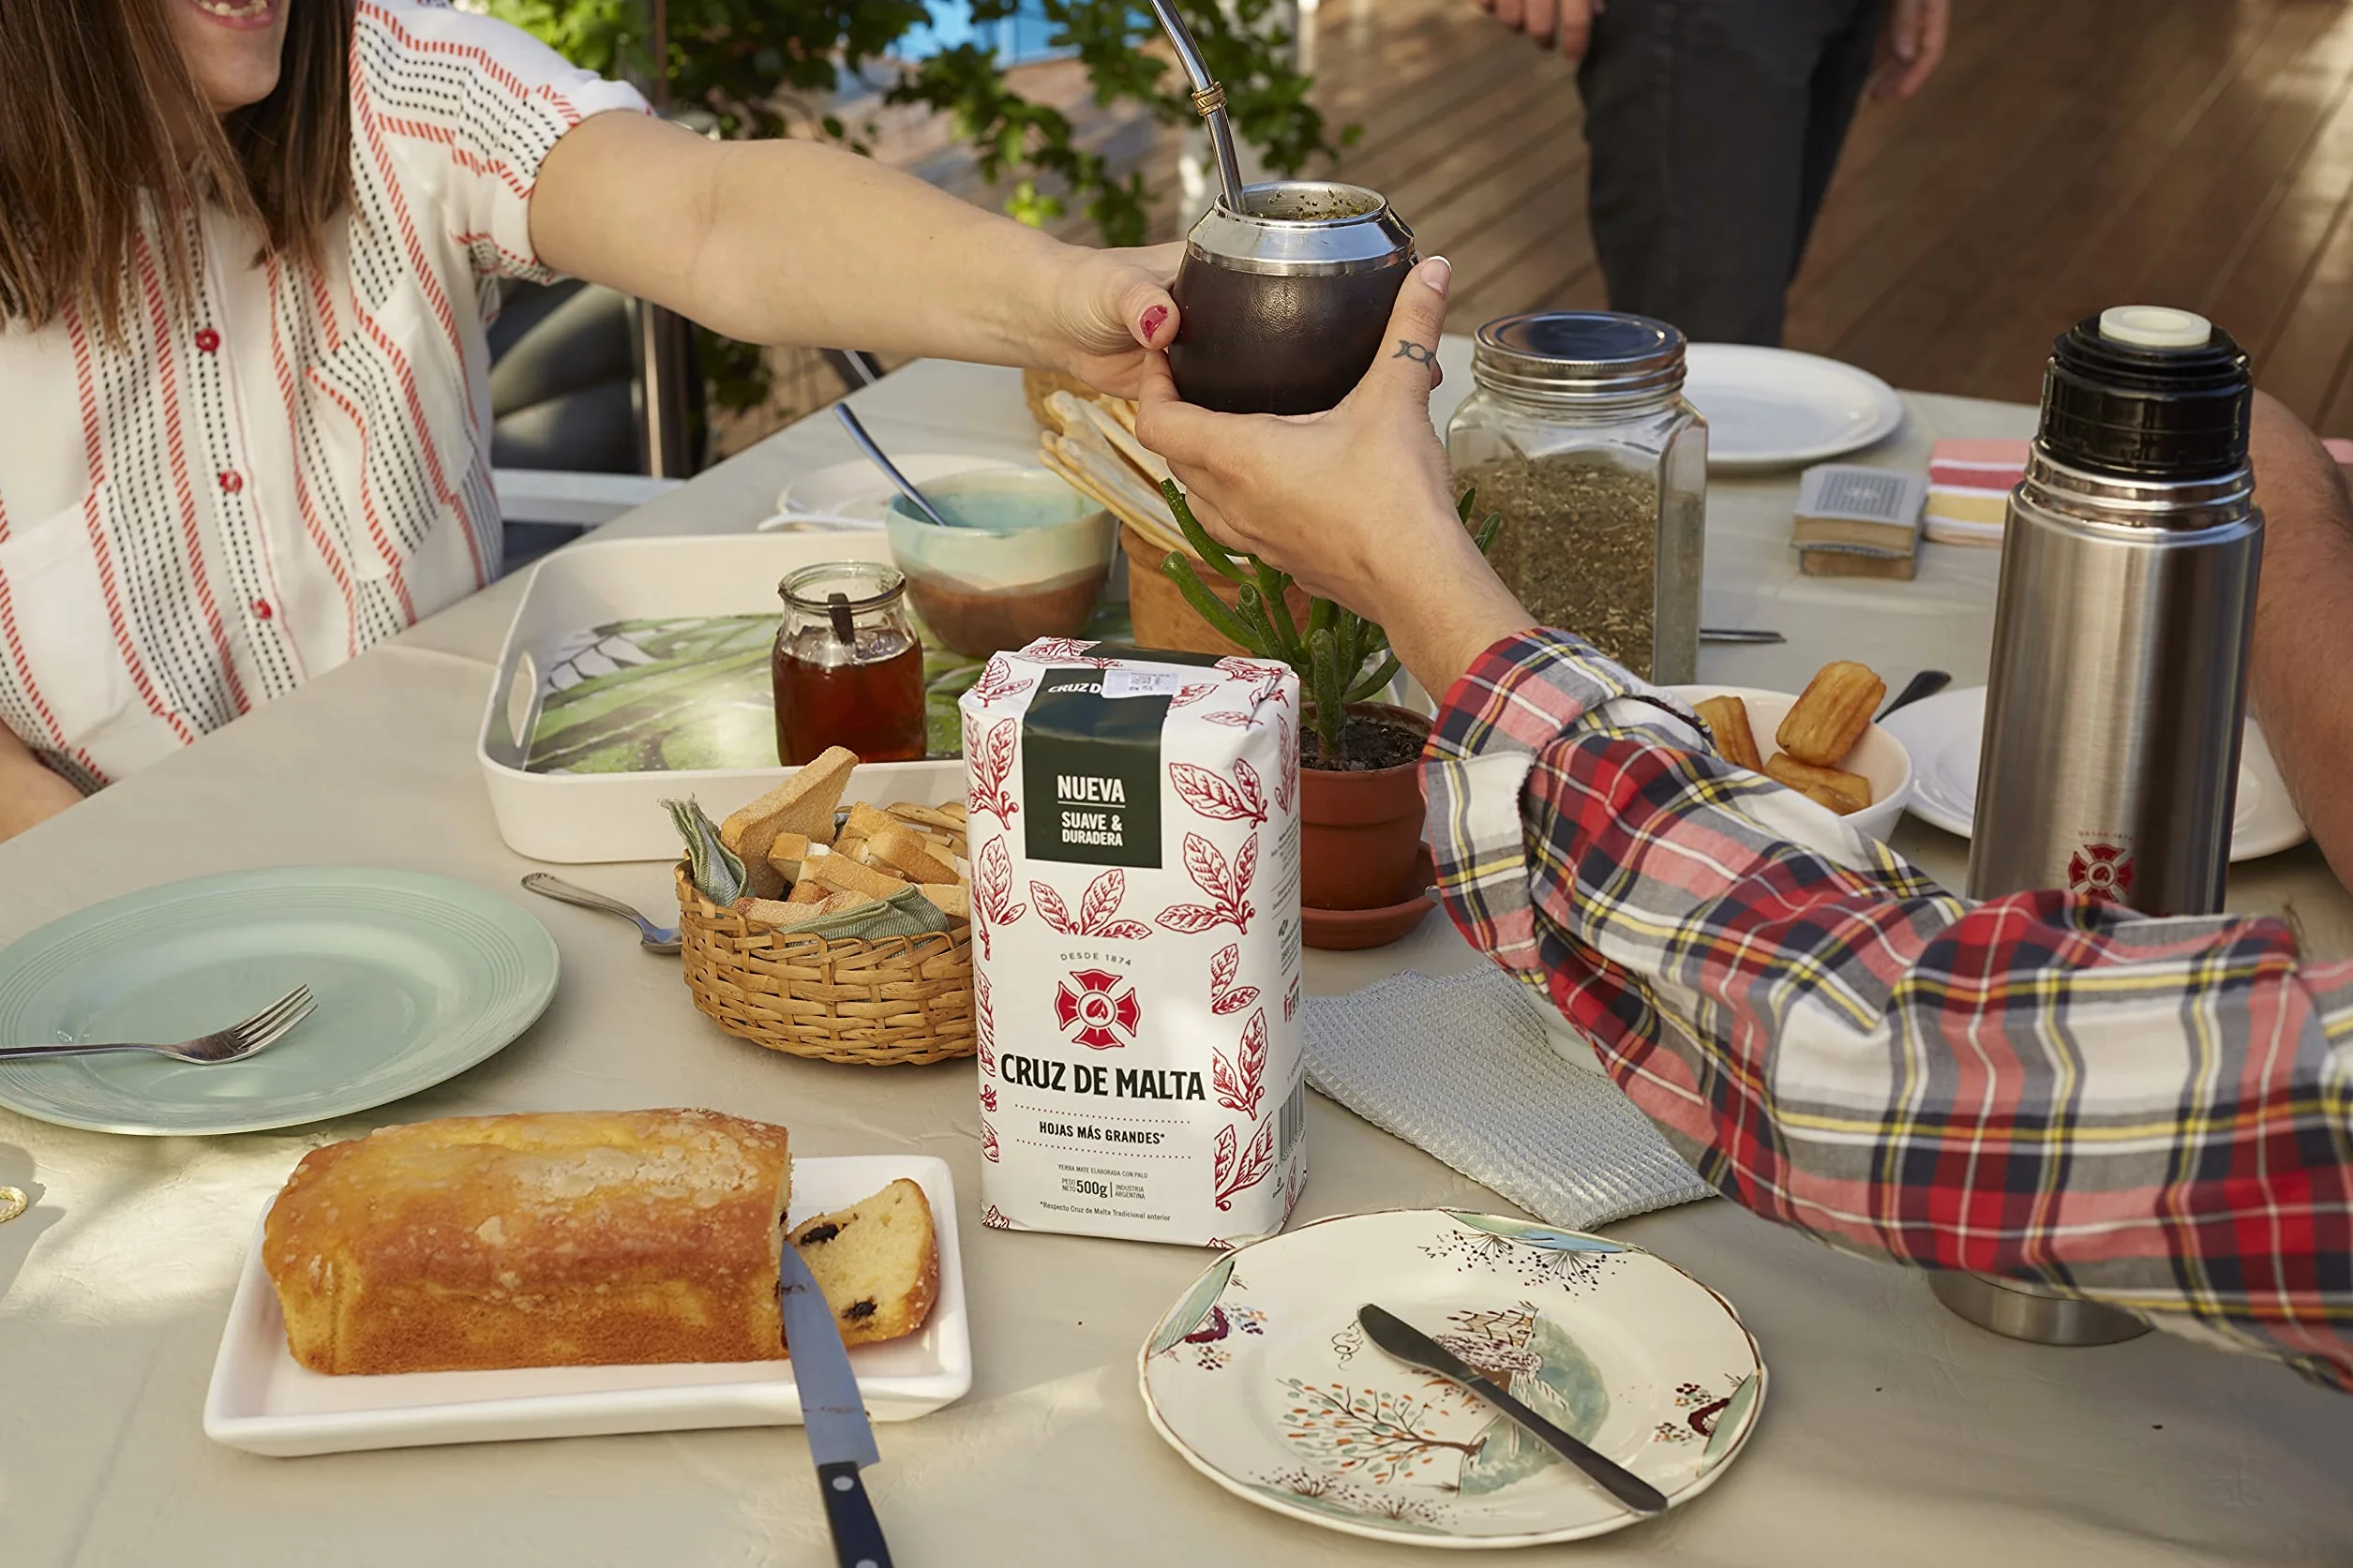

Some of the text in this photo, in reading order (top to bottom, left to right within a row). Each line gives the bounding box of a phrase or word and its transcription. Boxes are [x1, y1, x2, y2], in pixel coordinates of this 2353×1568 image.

[1047, 682, 1087, 693] CRUZ
[1057, 774, 1126, 802] NUEVA
[1061, 811, 1123, 832] SUAVE &
[1061, 829, 1123, 847] DURADERA
[1060, 951, 1132, 966] DESDE 1874
[1000, 1053, 1206, 1101] CRUZ DE MALTA
[1039, 1121, 1073, 1138] HOJAS
[1077, 1125, 1102, 1141] MÁS
[1057, 1164, 1075, 1172] YERBA
[1075, 1166, 1089, 1174] MATE
[1090, 1168, 1121, 1177] ELABORADA
[1061, 1177, 1076, 1186] PESO
[1061, 1179, 1108, 1199] NETO 500g
[1115, 1184, 1145, 1193] INDUSTRIA
[1115, 1191, 1146, 1200] ARGENTINA
[1070, 1205, 1084, 1214] Cruz
[1094, 1208, 1112, 1217] Malta
[1112, 1209, 1146, 1219] Tradicional
